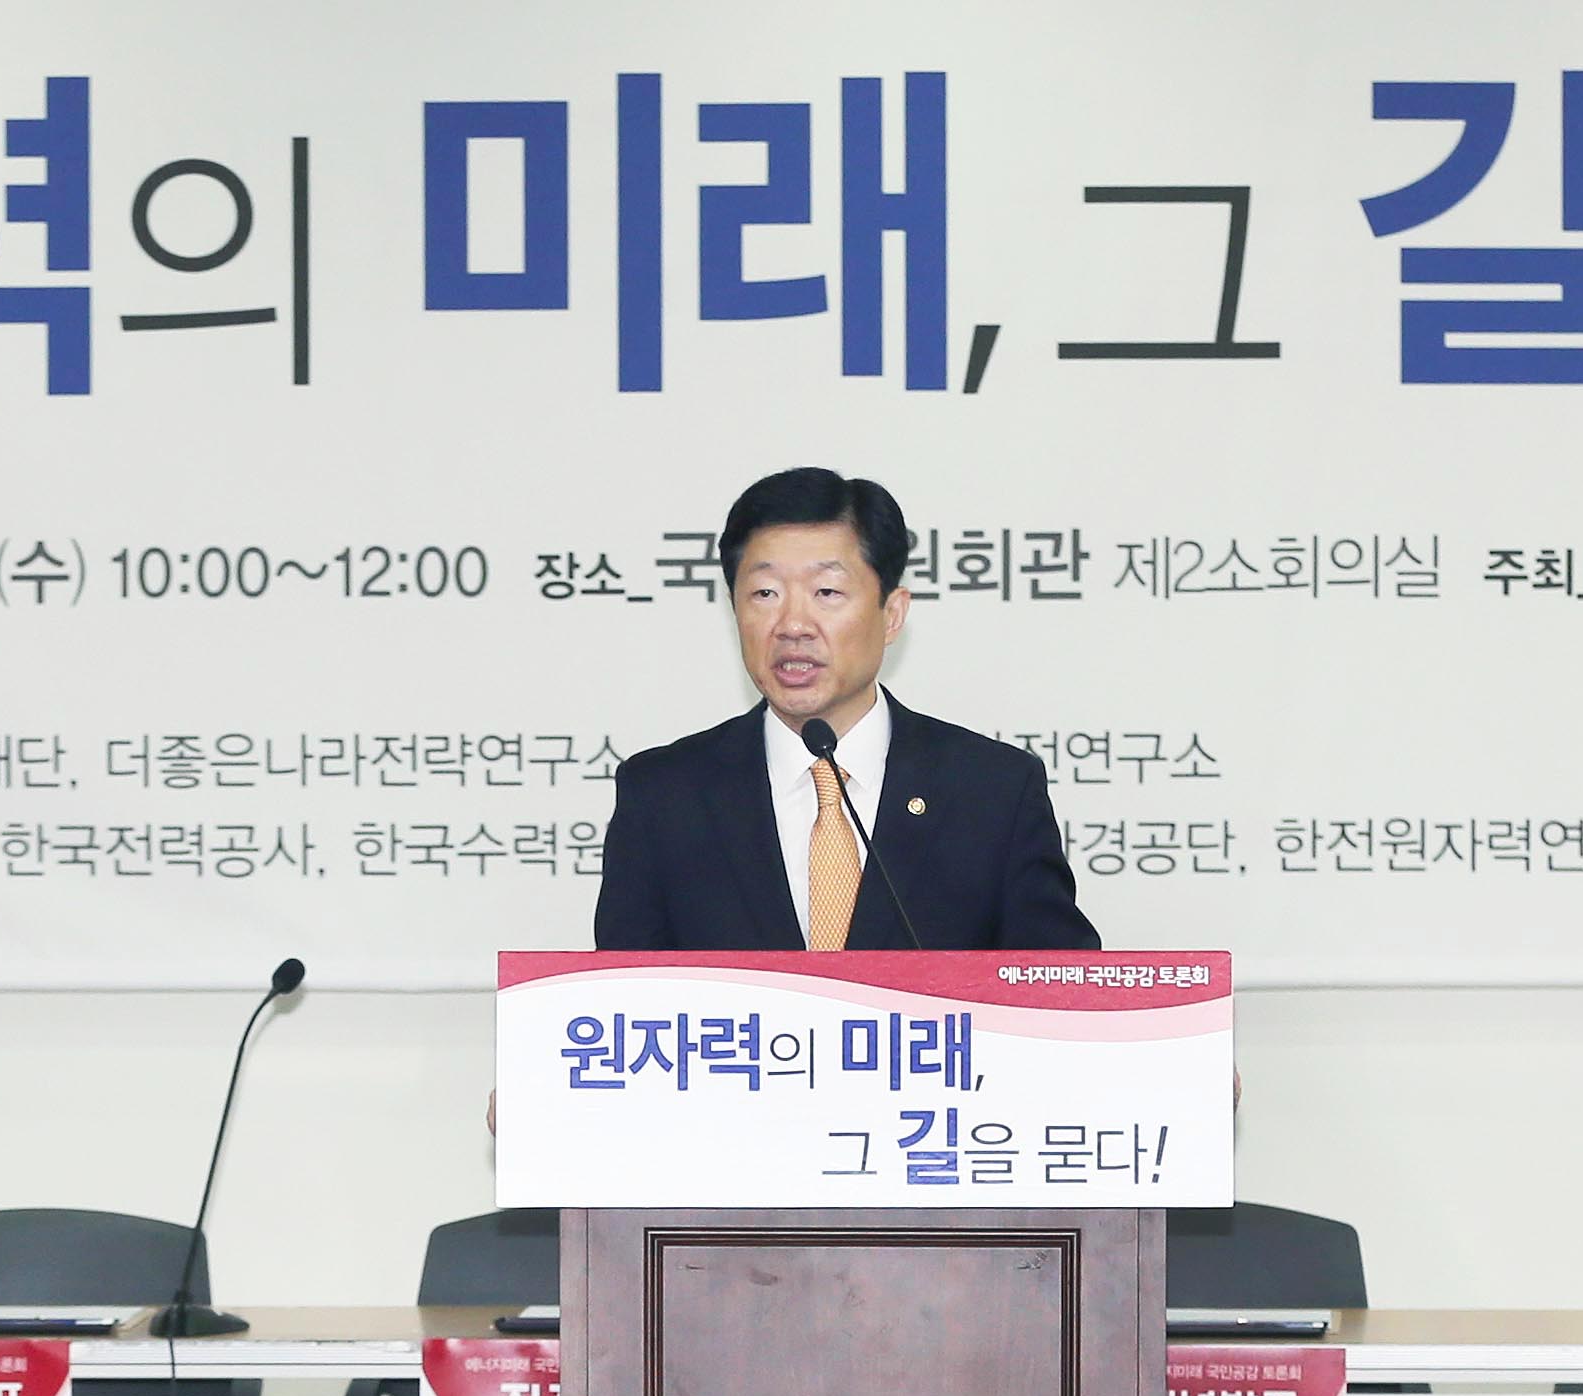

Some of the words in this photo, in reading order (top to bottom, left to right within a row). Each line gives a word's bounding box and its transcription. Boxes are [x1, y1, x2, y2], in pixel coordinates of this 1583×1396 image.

[422, 70, 1002, 395] 미래,
[1057, 185, 1282, 361] 그
[111, 545, 489, 599] 10:00~12:00
[1113, 534, 1440, 600] 제2소회의실
[106, 732, 623, 790] 더좋은나라전략연구소
[0, 823, 325, 879] 한국전력공사,
[998, 965, 1084, 985] 에너지미래
[1086, 965, 1155, 988] 국민공감
[1157, 965, 1210, 988] 토론회
[560, 1012, 815, 1092] 원자력의
[841, 1012, 985, 1092] 미래,
[821, 1131, 878, 1176] 그
[896, 1107, 1020, 1186] 길을
[1037, 1123, 1169, 1185] 묻다!
